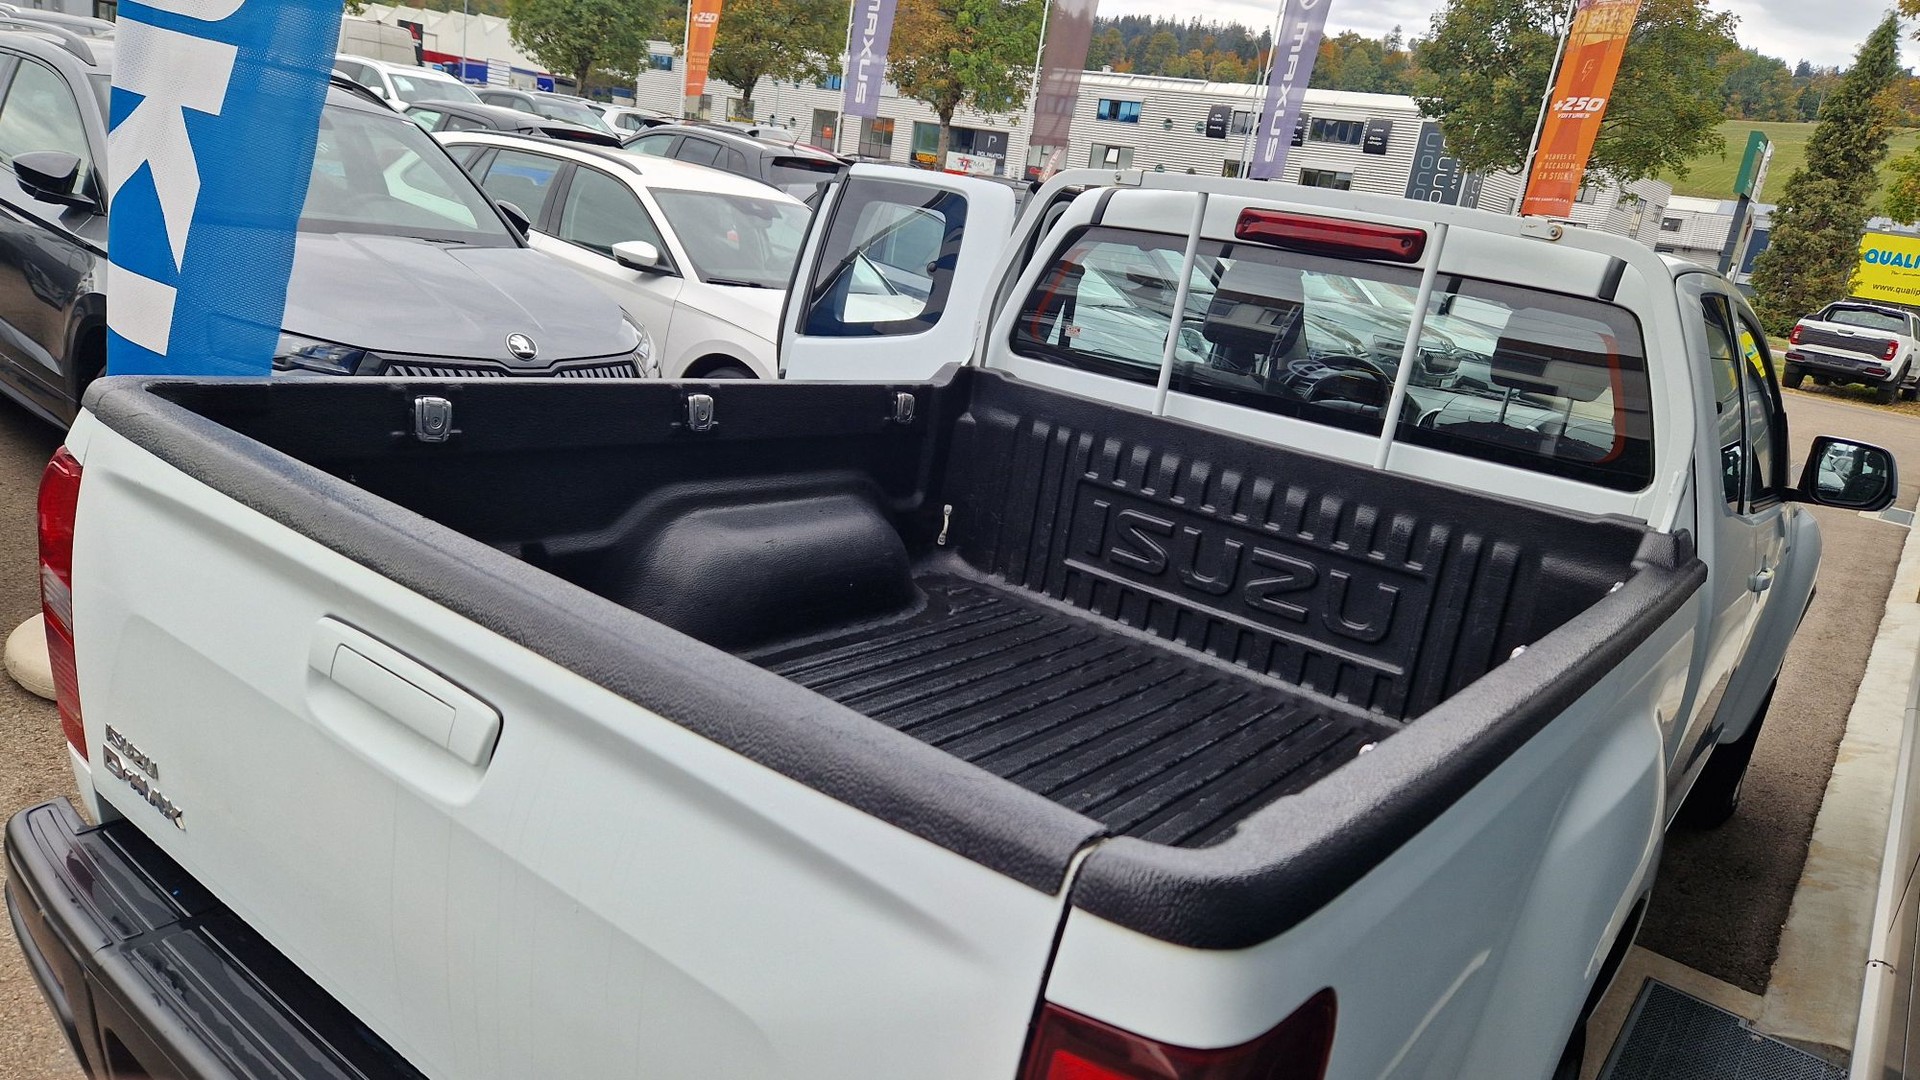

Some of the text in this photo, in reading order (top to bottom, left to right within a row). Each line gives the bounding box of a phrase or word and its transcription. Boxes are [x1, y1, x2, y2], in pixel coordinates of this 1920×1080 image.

[1265, 22, 1309, 162] MAXUS
[1553, 96, 1606, 112] +250
[1087, 499, 1399, 645] ISUZU
[105, 722, 159, 781] ISUZU
